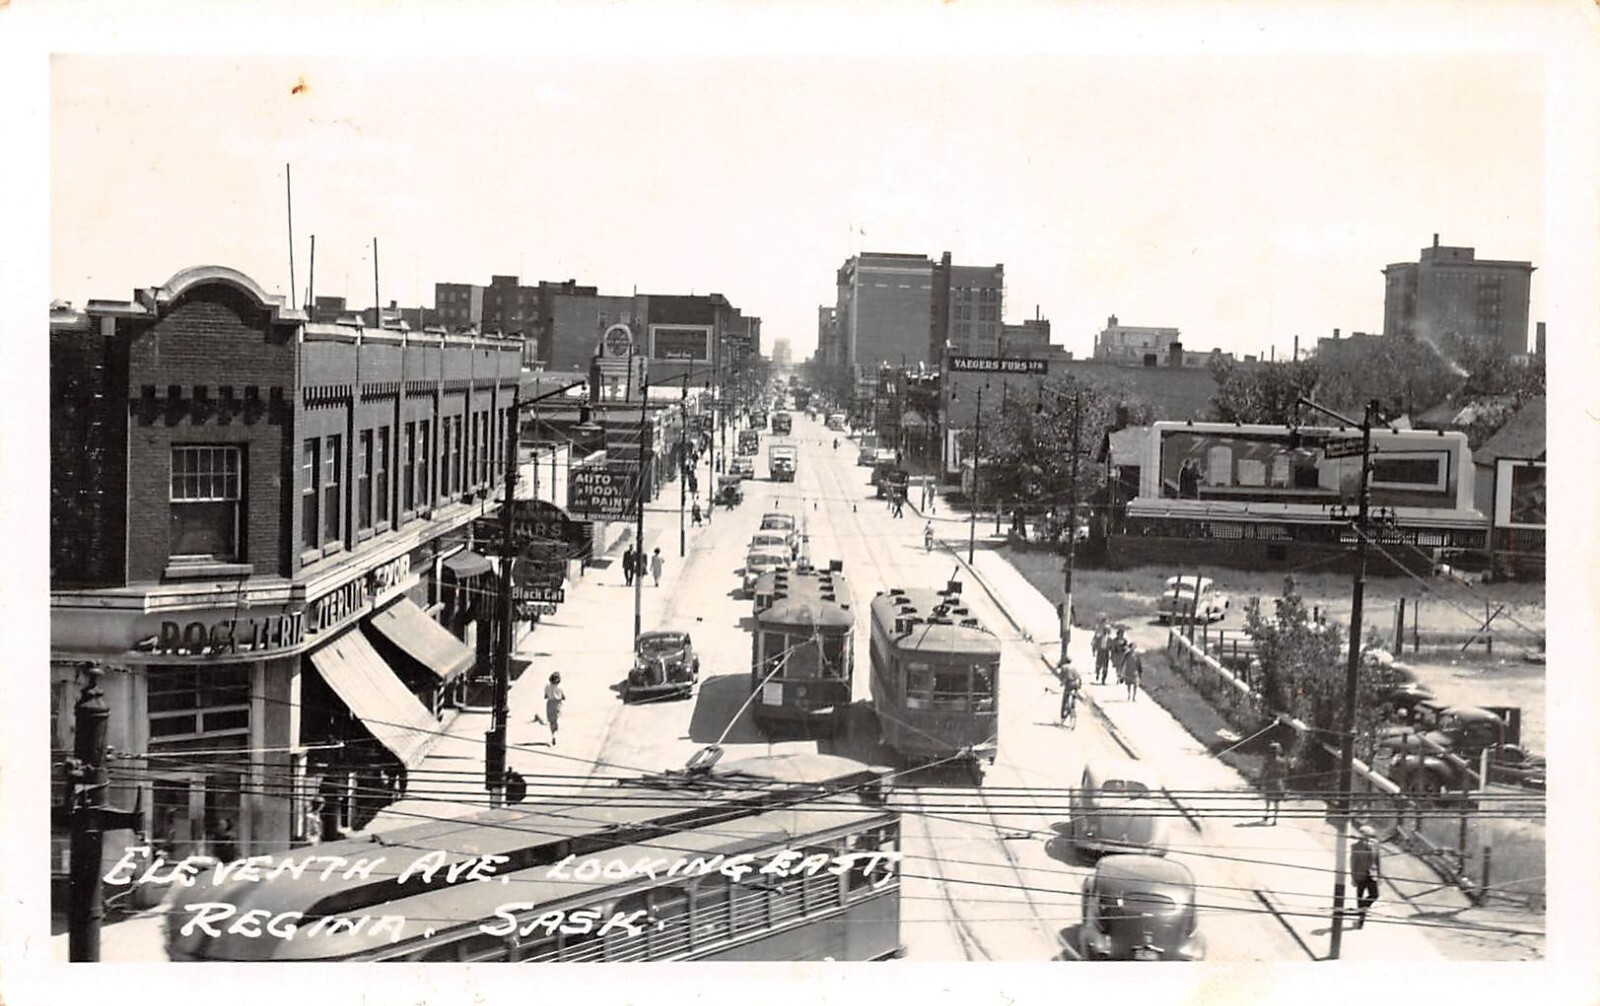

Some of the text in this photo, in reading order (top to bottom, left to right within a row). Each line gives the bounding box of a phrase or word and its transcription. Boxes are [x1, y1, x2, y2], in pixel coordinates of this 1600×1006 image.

[955, 359, 999, 370] YAEGERS
[1001, 361, 1027, 371] FURS
[575, 474, 611, 484] AUTO
[591, 497, 631, 509] PAINT
[512, 587, 562, 600] Black Cat
